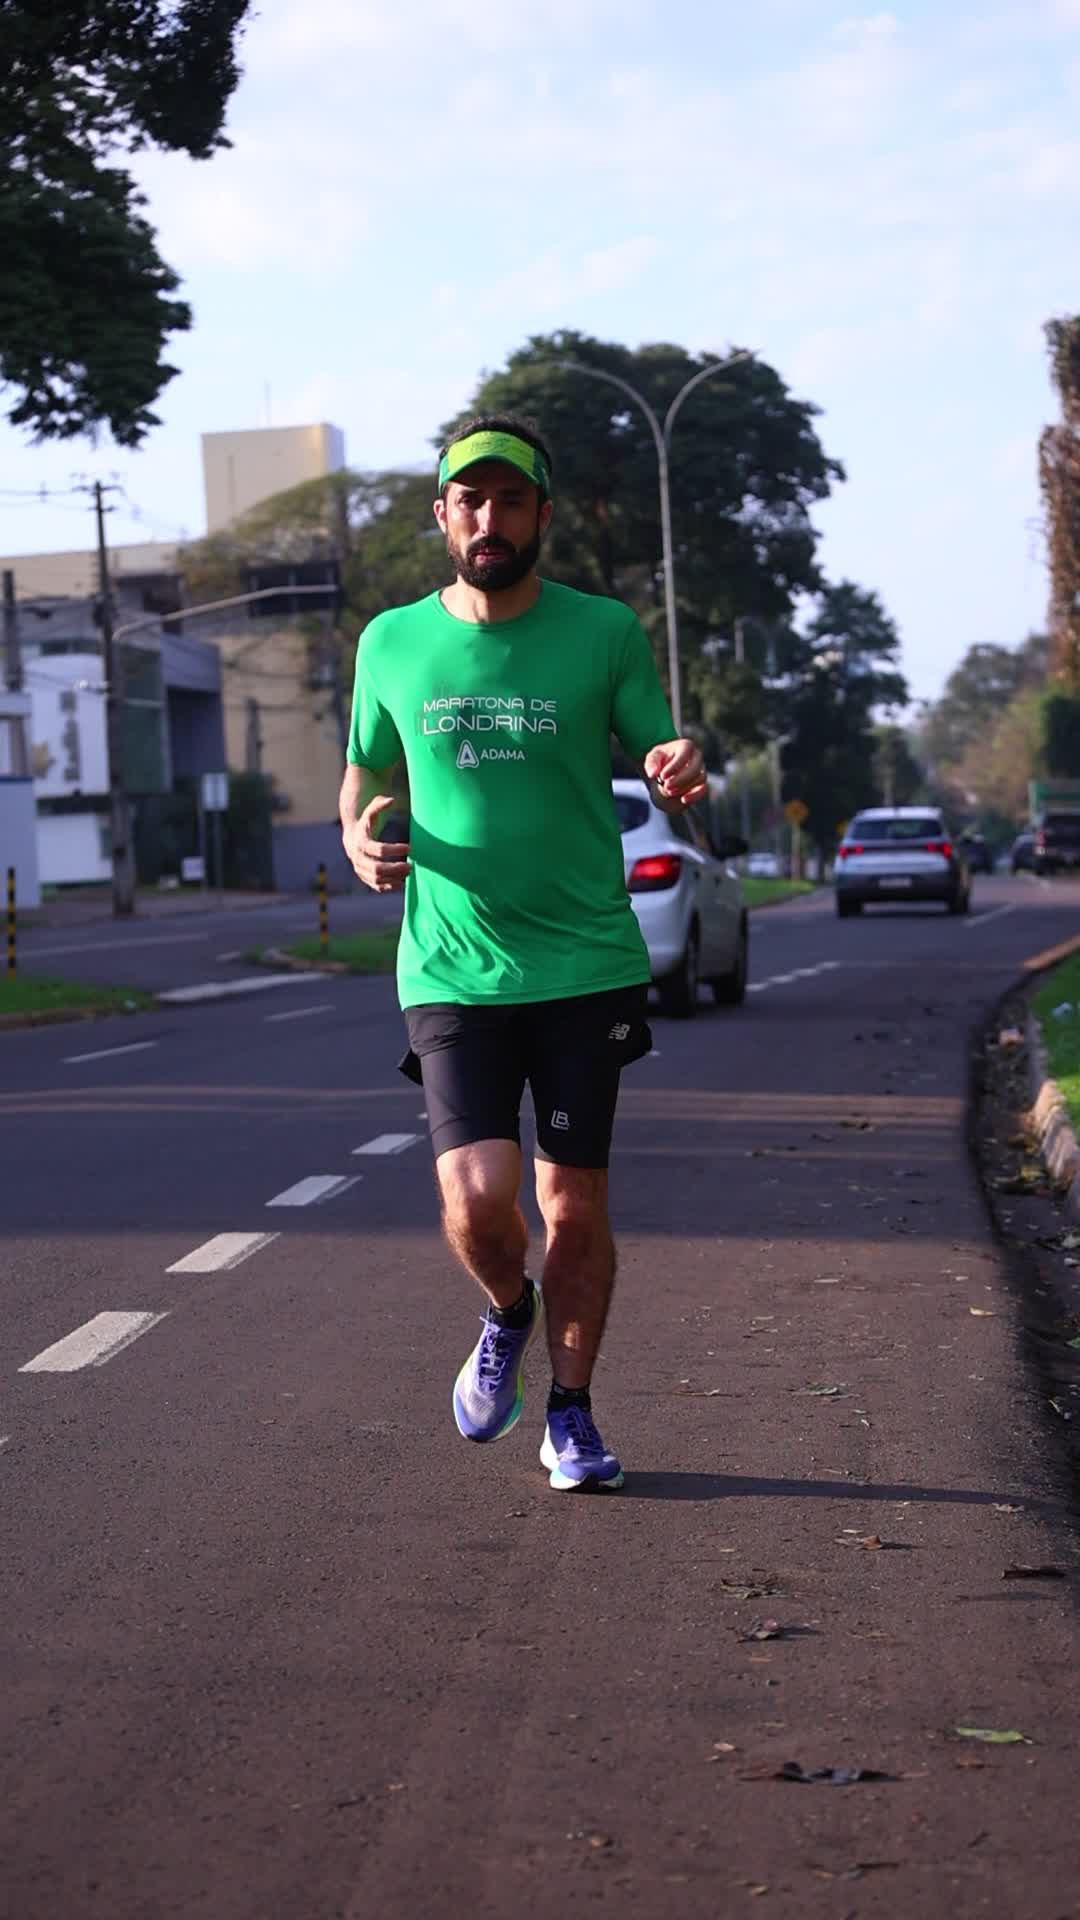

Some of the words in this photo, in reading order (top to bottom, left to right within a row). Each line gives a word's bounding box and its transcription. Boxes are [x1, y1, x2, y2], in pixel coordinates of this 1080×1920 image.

[423, 697, 525, 713] MARATONA
[530, 698, 557, 713] DE
[423, 714, 557, 735] LONDRINA
[480, 748, 526, 761] ADAMA
